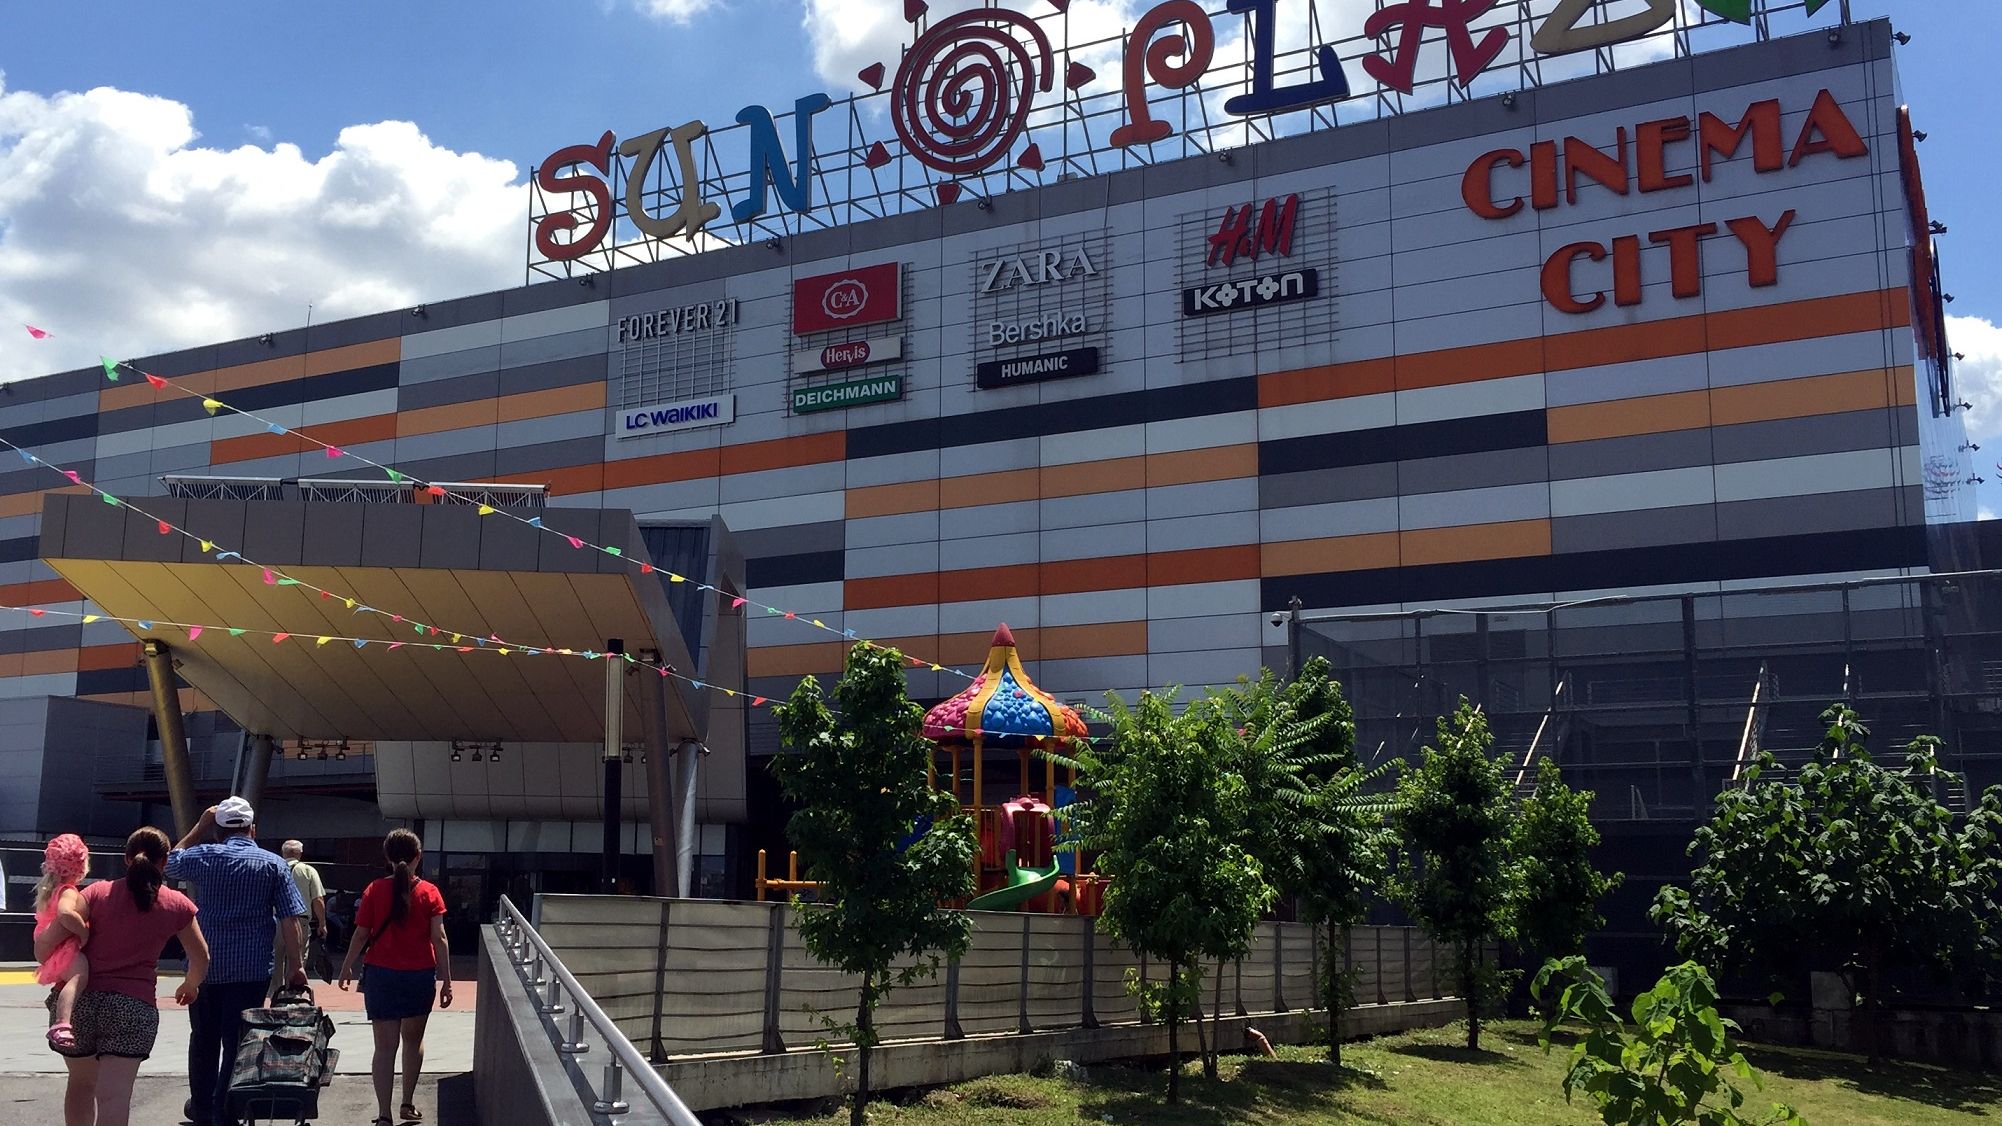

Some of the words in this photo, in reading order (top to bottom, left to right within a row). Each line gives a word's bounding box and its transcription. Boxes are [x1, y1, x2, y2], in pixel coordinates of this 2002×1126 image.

[1461, 88, 1869, 220] CINEMA
[535, 93, 832, 261] SUN
[1207, 193, 1298, 267] H&M
[981, 248, 1098, 293] ZARA
[1540, 209, 1796, 313] CITY
[830, 288, 860, 309] C&A
[617, 303, 709, 343] FOREVER
[716, 298, 739, 327] 21
[988, 311, 1086, 346] Bershka
[826, 345, 867, 364] Hervis
[1001, 355, 1068, 379] HUMANIC
[795, 380, 896, 407] DEICHMANN
[625, 412, 648, 430] LC
